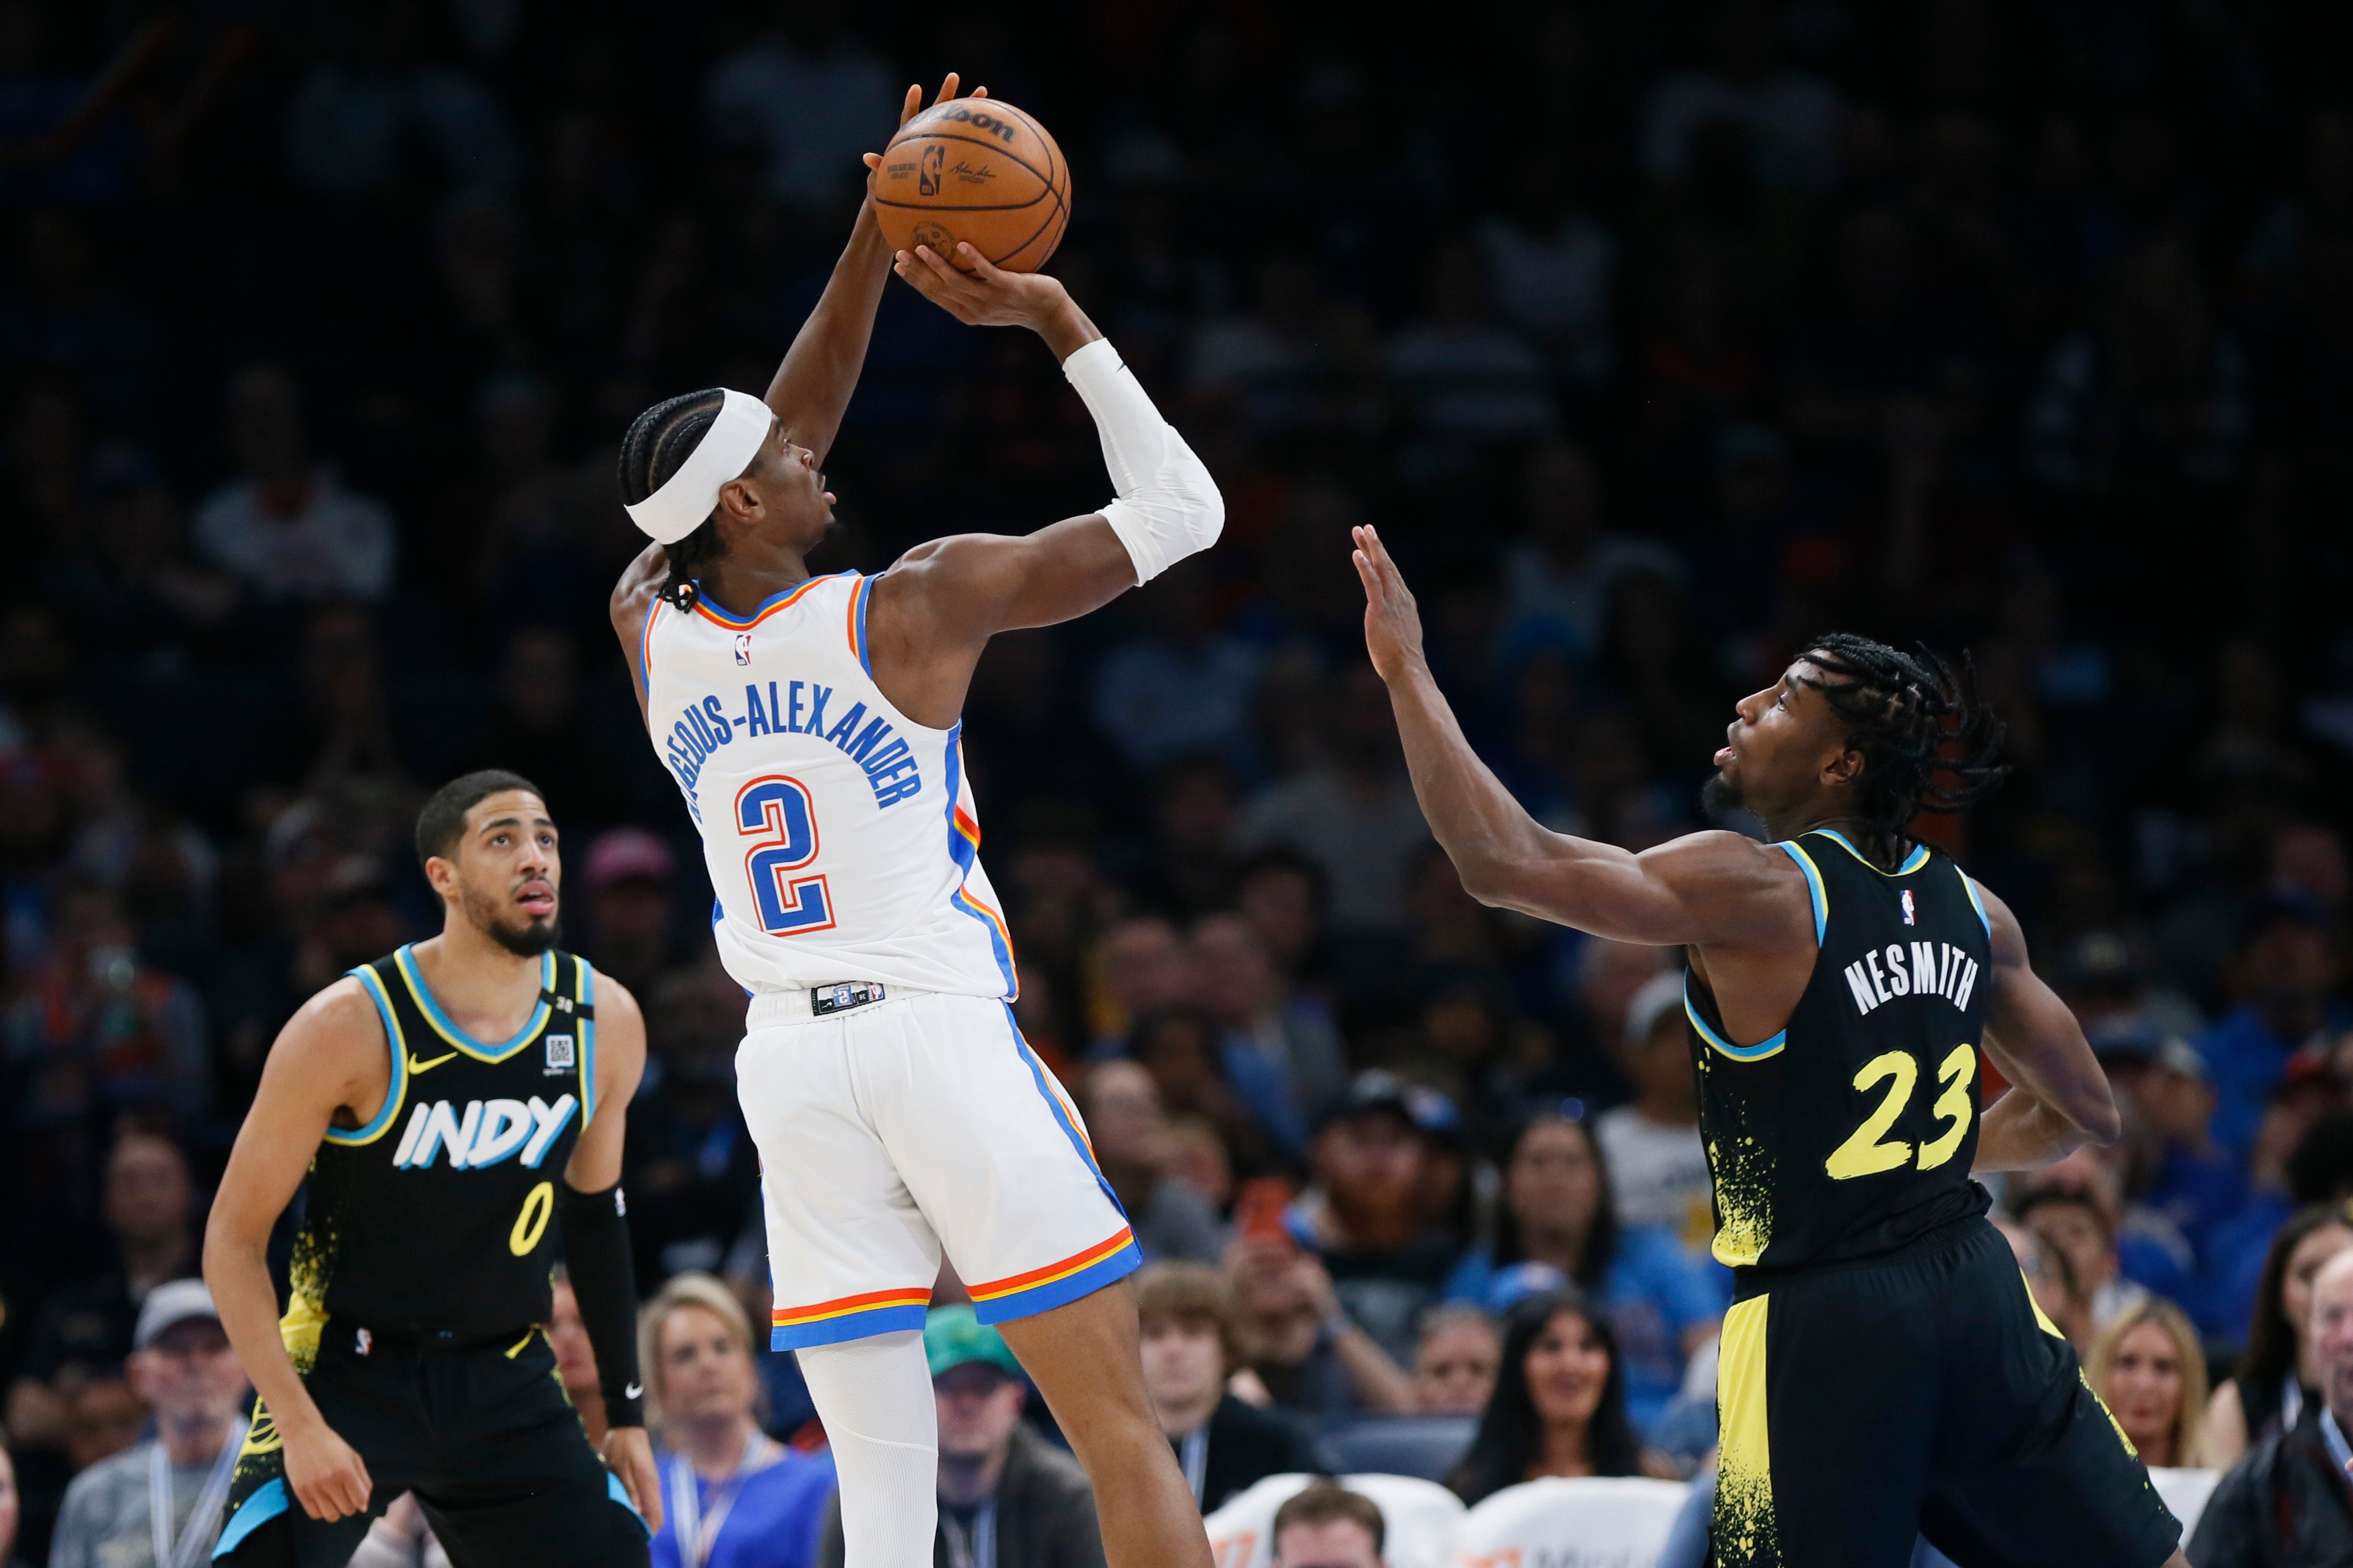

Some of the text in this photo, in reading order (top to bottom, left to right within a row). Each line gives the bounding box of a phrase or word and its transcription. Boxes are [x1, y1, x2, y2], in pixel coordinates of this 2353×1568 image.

[667, 680, 922, 826] GEOUS-ALEXANDER
[734, 774, 836, 937] 2
[1844, 941, 1979, 1016] NESMITH
[392, 1093, 579, 1170] INDY
[1825, 1043, 1976, 1180] 23
[509, 1181, 554, 1257] 0
